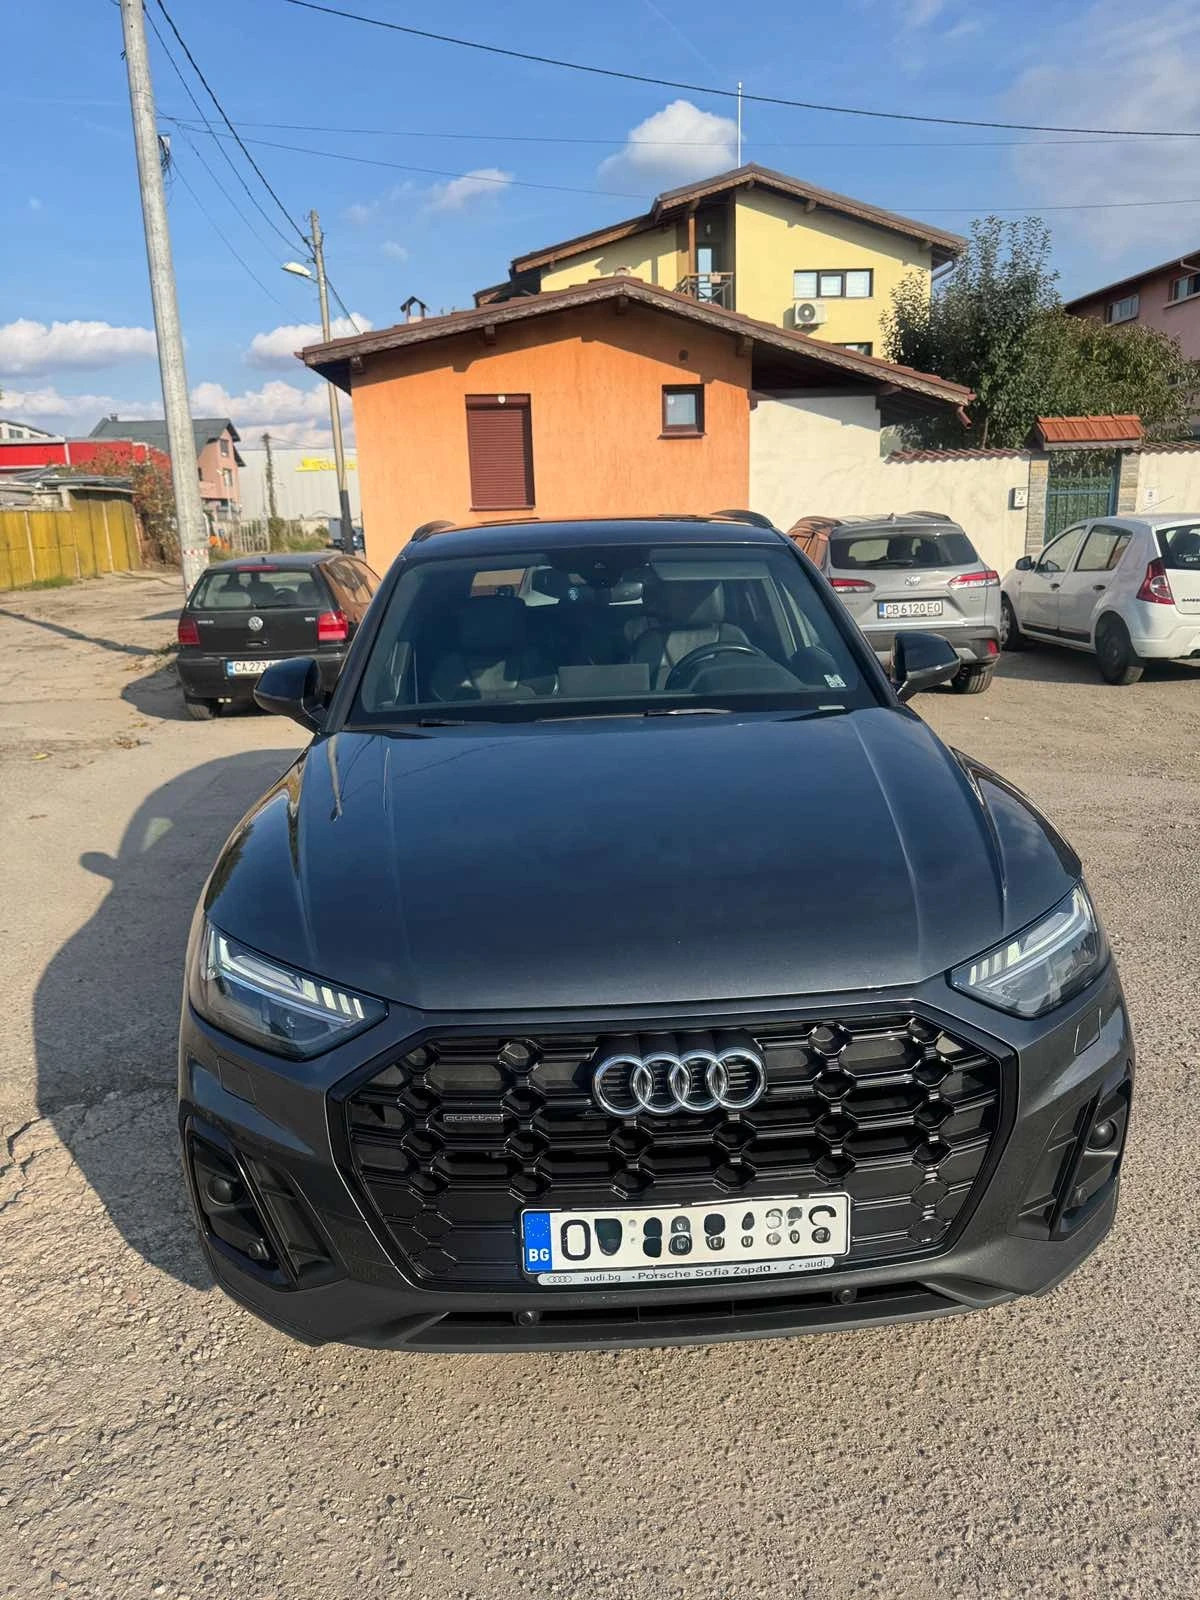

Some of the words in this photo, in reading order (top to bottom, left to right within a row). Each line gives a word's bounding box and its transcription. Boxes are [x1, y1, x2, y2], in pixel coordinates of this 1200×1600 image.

[528, 1248, 550, 1262] BG
[584, 1274, 621, 1283] audi.bg
[637, 1269, 691, 1280] Porsche
[695, 1267, 729, 1277] Sofia
